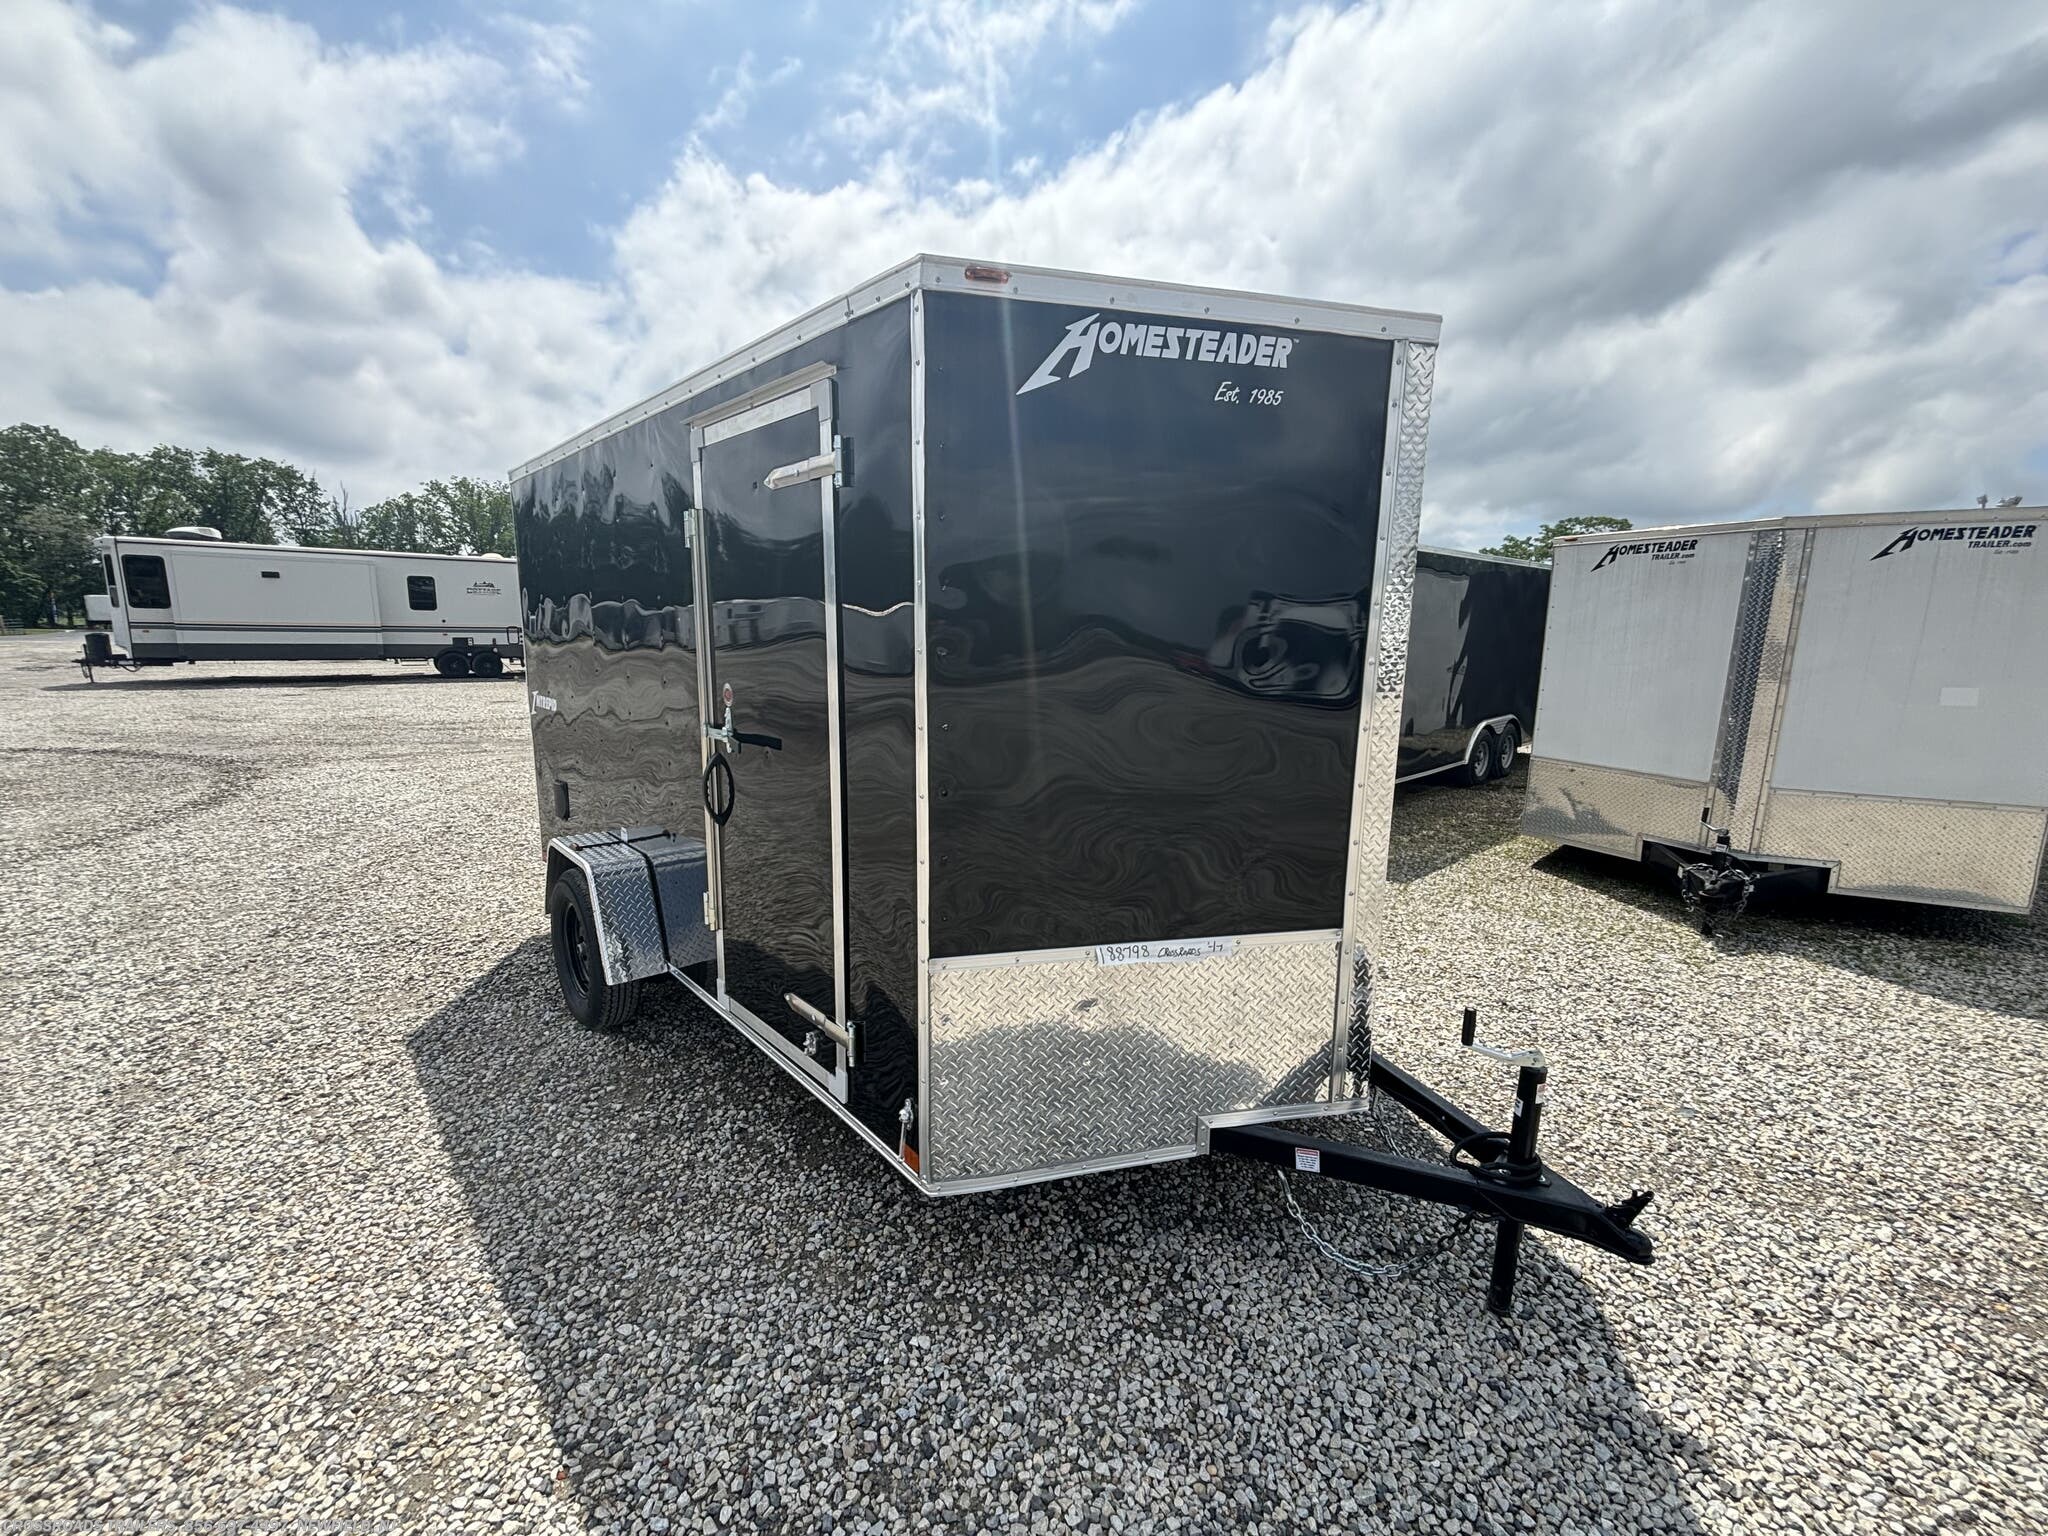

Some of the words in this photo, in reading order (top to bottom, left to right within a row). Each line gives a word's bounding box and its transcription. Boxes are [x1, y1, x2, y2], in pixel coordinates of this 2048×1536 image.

[1016, 313, 1293, 395] HOMESTEADER
[1248, 388, 1284, 406] 1985
[1591, 539, 1697, 572] HOMESTEADER
[1869, 525, 2037, 561] HOMESTEADER
